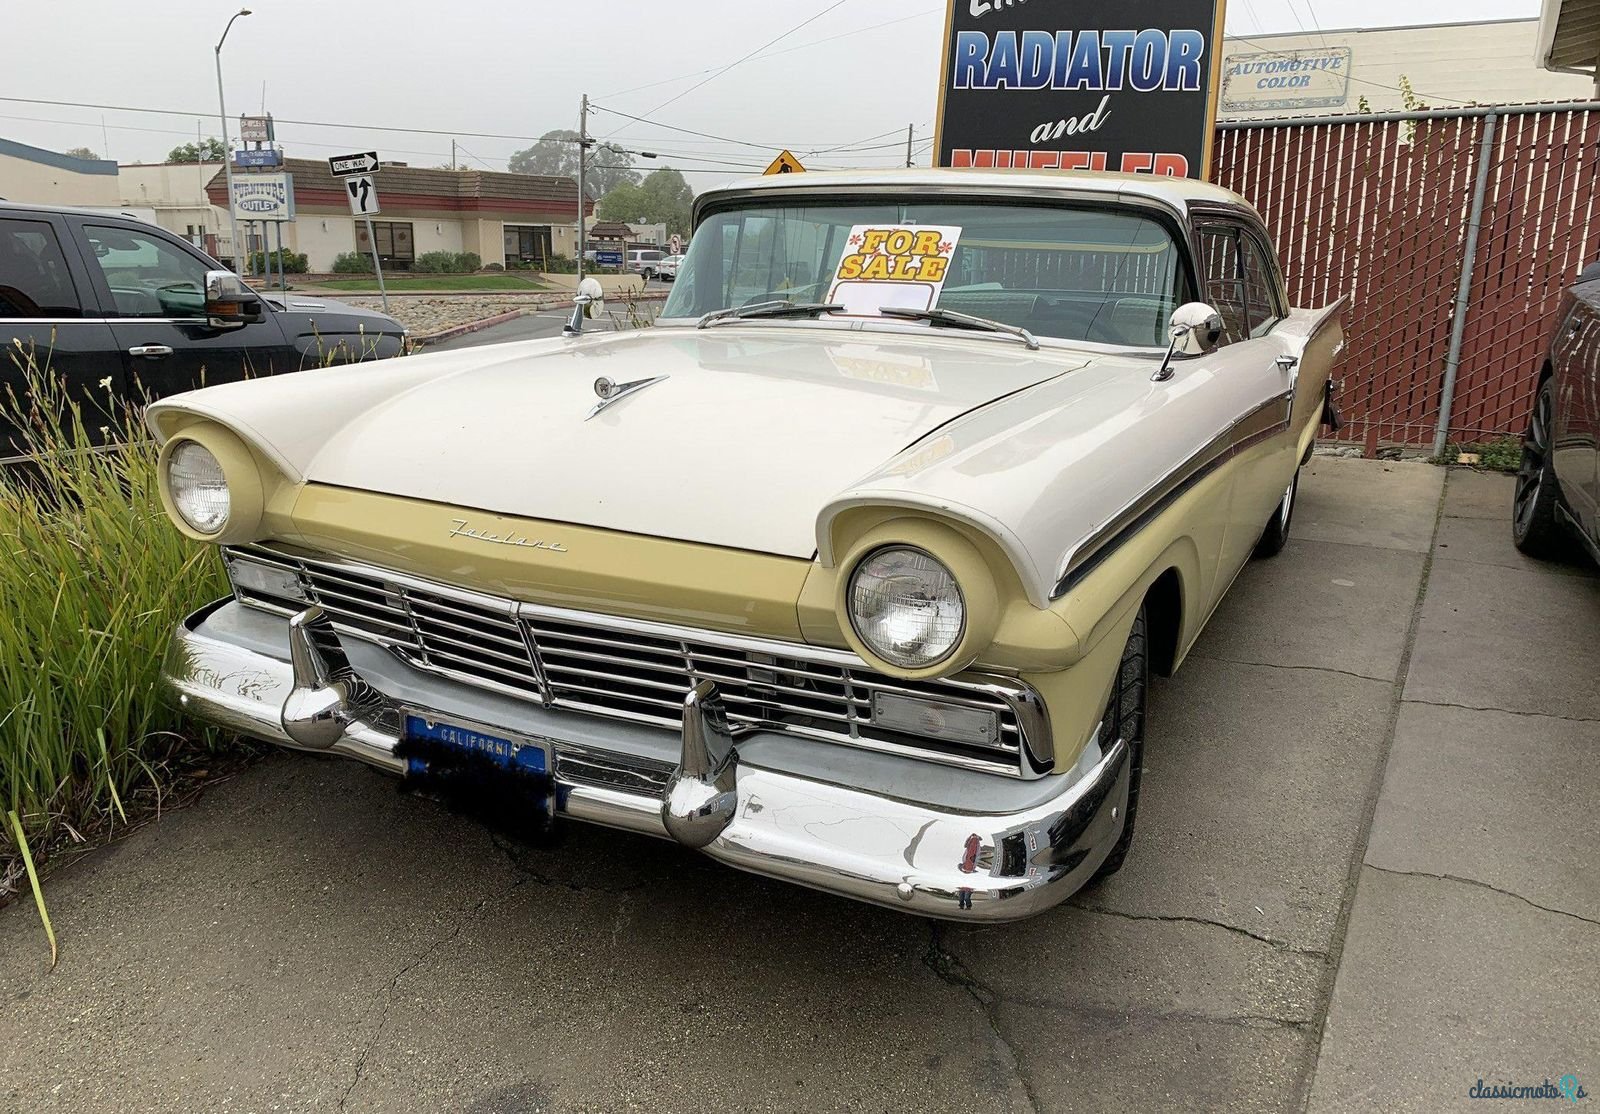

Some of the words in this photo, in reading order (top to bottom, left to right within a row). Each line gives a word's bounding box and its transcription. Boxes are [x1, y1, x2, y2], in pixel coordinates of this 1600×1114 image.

[953, 28, 1204, 91] RADIATOR
[1232, 57, 1343, 76] AUTOMOTIVE
[1256, 75, 1311, 89] COLOR
[1030, 95, 1112, 143] and
[335, 161, 349, 170] ONE
[352, 159, 366, 168] WAY
[233, 182, 285, 204] FURNITURE
[242, 201, 277, 211] OUTLET
[858, 229, 942, 256] FOR
[837, 254, 949, 282] SALE
[441, 728, 518, 757] CALIFORNIA
